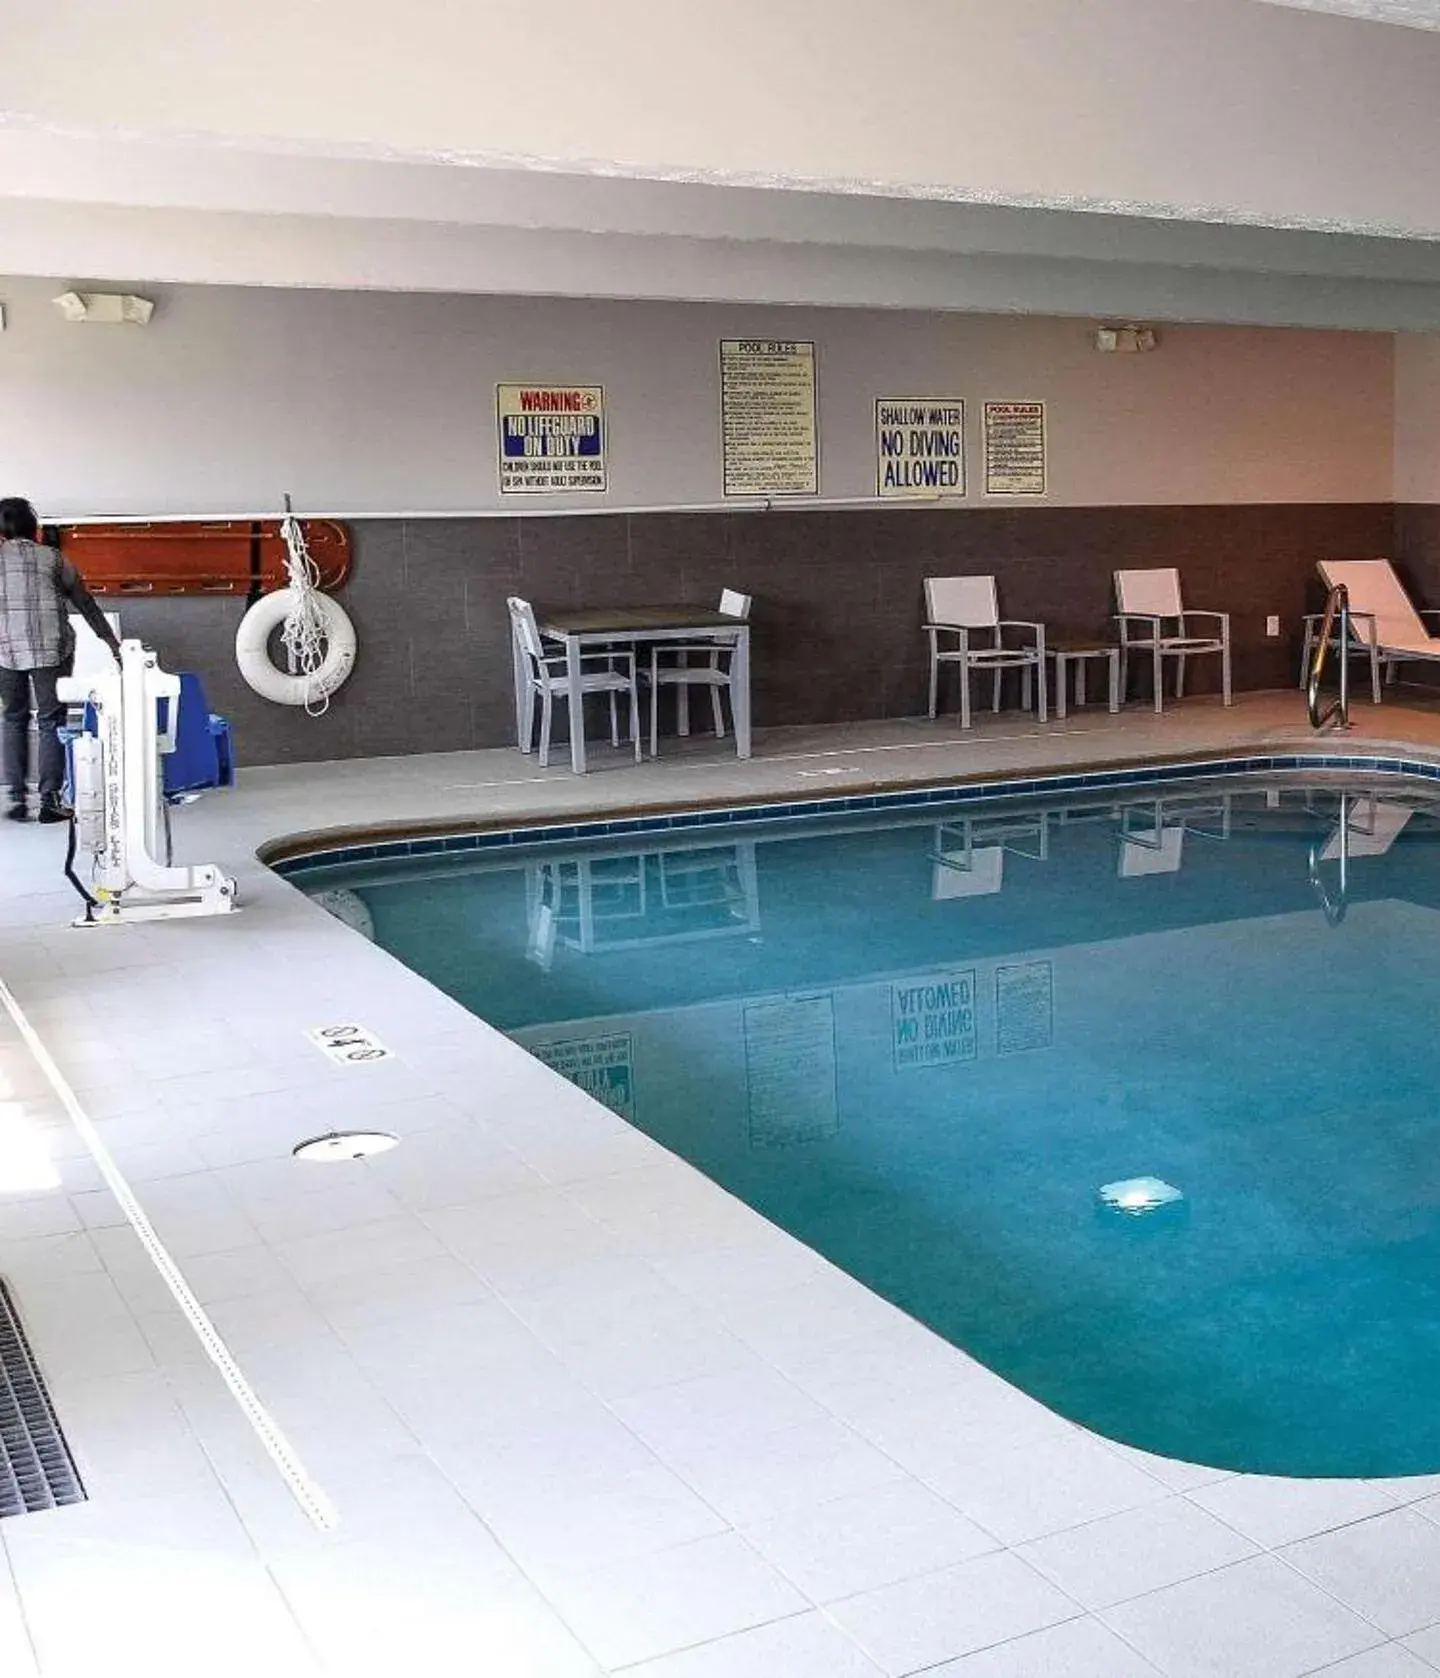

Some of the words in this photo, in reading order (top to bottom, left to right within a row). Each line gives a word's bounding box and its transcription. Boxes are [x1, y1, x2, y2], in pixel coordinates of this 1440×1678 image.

[739, 343, 761, 352] POOL
[767, 343, 797, 353] RULES
[520, 391, 581, 411] WARNING
[507, 416, 526, 435] NO
[527, 416, 594, 436] LIFEGUARD
[880, 407, 926, 425] SHALLOW
[929, 409, 959, 425] WATER
[524, 436, 542, 455] ON
[547, 435, 580, 455] DUTY
[881, 430, 903, 456] NO
[910, 430, 959, 456] DIVING
[885, 460, 958, 487] ALLOWED
